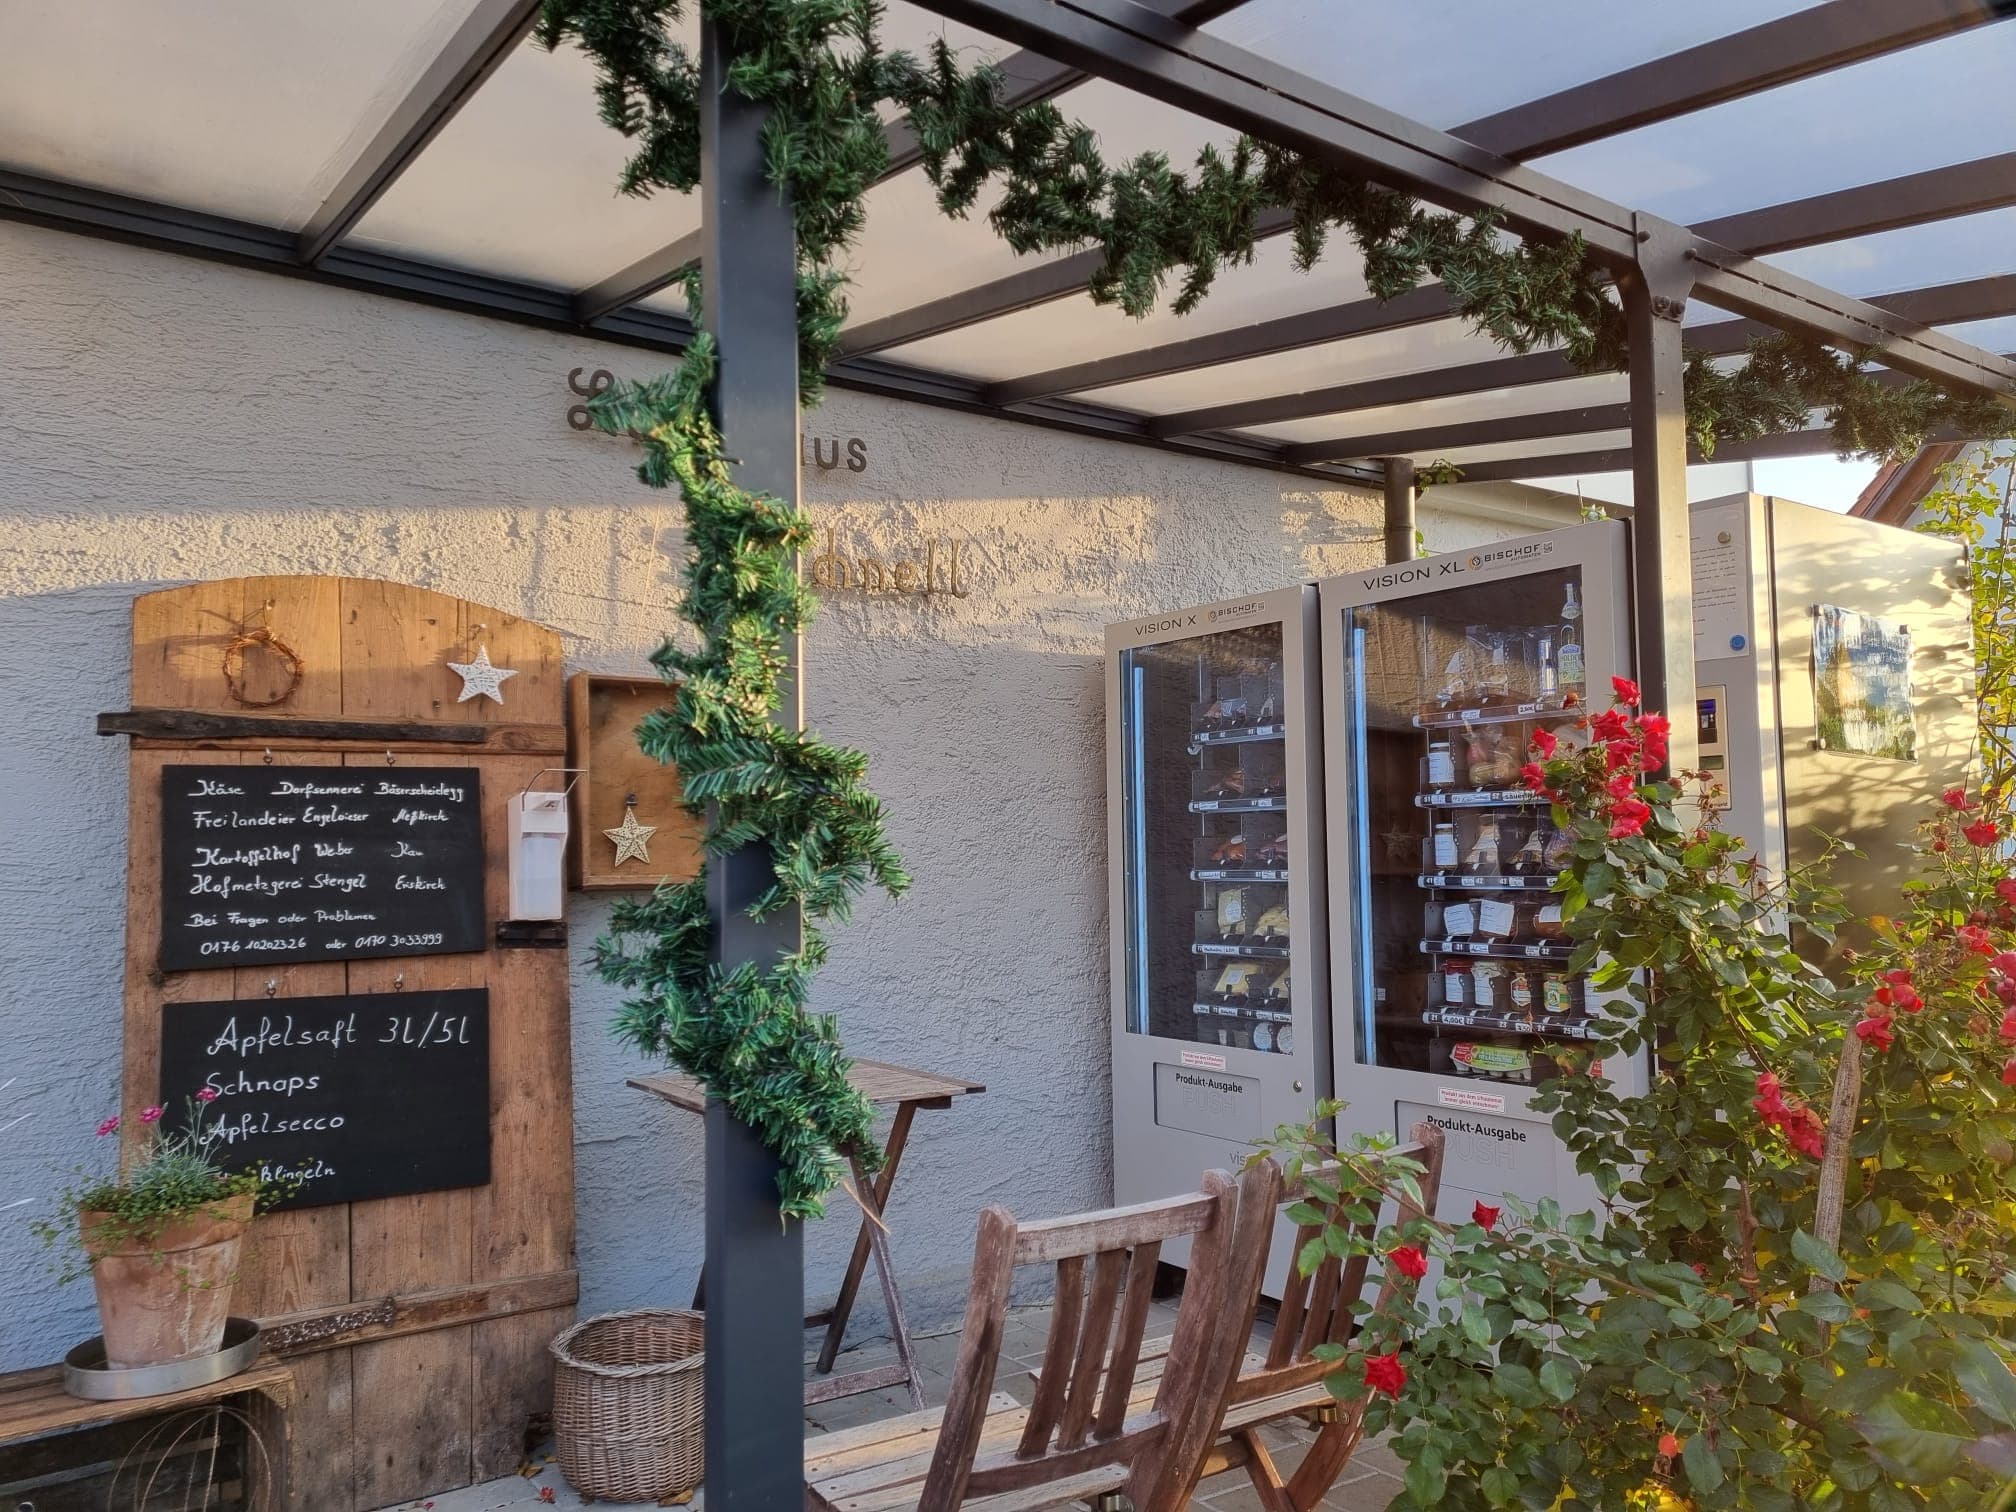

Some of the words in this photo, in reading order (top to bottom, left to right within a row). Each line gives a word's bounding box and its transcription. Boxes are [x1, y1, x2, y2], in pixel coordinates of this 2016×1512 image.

[1363, 567, 1430, 591] VISION
[1439, 561, 1465, 577] XL
[1484, 543, 1541, 563] BISCHOF
[1135, 617, 1182, 637] VISION
[1187, 614, 1197, 626] X
[1218, 602, 1257, 617] BISCHOF
[187, 779, 246, 797] Käse
[269, 781, 365, 799] Dorfsennerei
[192, 810, 297, 829] Freilandeier
[191, 843, 301, 867] Kartoffelhof
[314, 840, 355, 857] Weber
[189, 873, 304, 899] Hofmetzgerei
[308, 873, 367, 893] Stengel
[394, 874, 447, 890] Eriskirch
[183, 912, 219, 927] Bei
[226, 911, 269, 928] Fragen
[277, 912, 307, 924] oder
[312, 909, 377, 923] Problemen
[200, 940, 241, 955] 0176
[325, 938, 347, 949] oder
[354, 935, 386, 949] 0170
[389, 933, 443, 947] 3033999
[207, 1013, 357, 1057] Apfelsaft
[206, 1070, 320, 1097] Schnaps
[1175, 1073, 1244, 1094] Produkt-Ausgabe
[199, 1113, 345, 1144] Apfelsecco
[1427, 1114, 1526, 1142] Produkt-Ausgabe
[260, 1159, 336, 1186] klingeln
